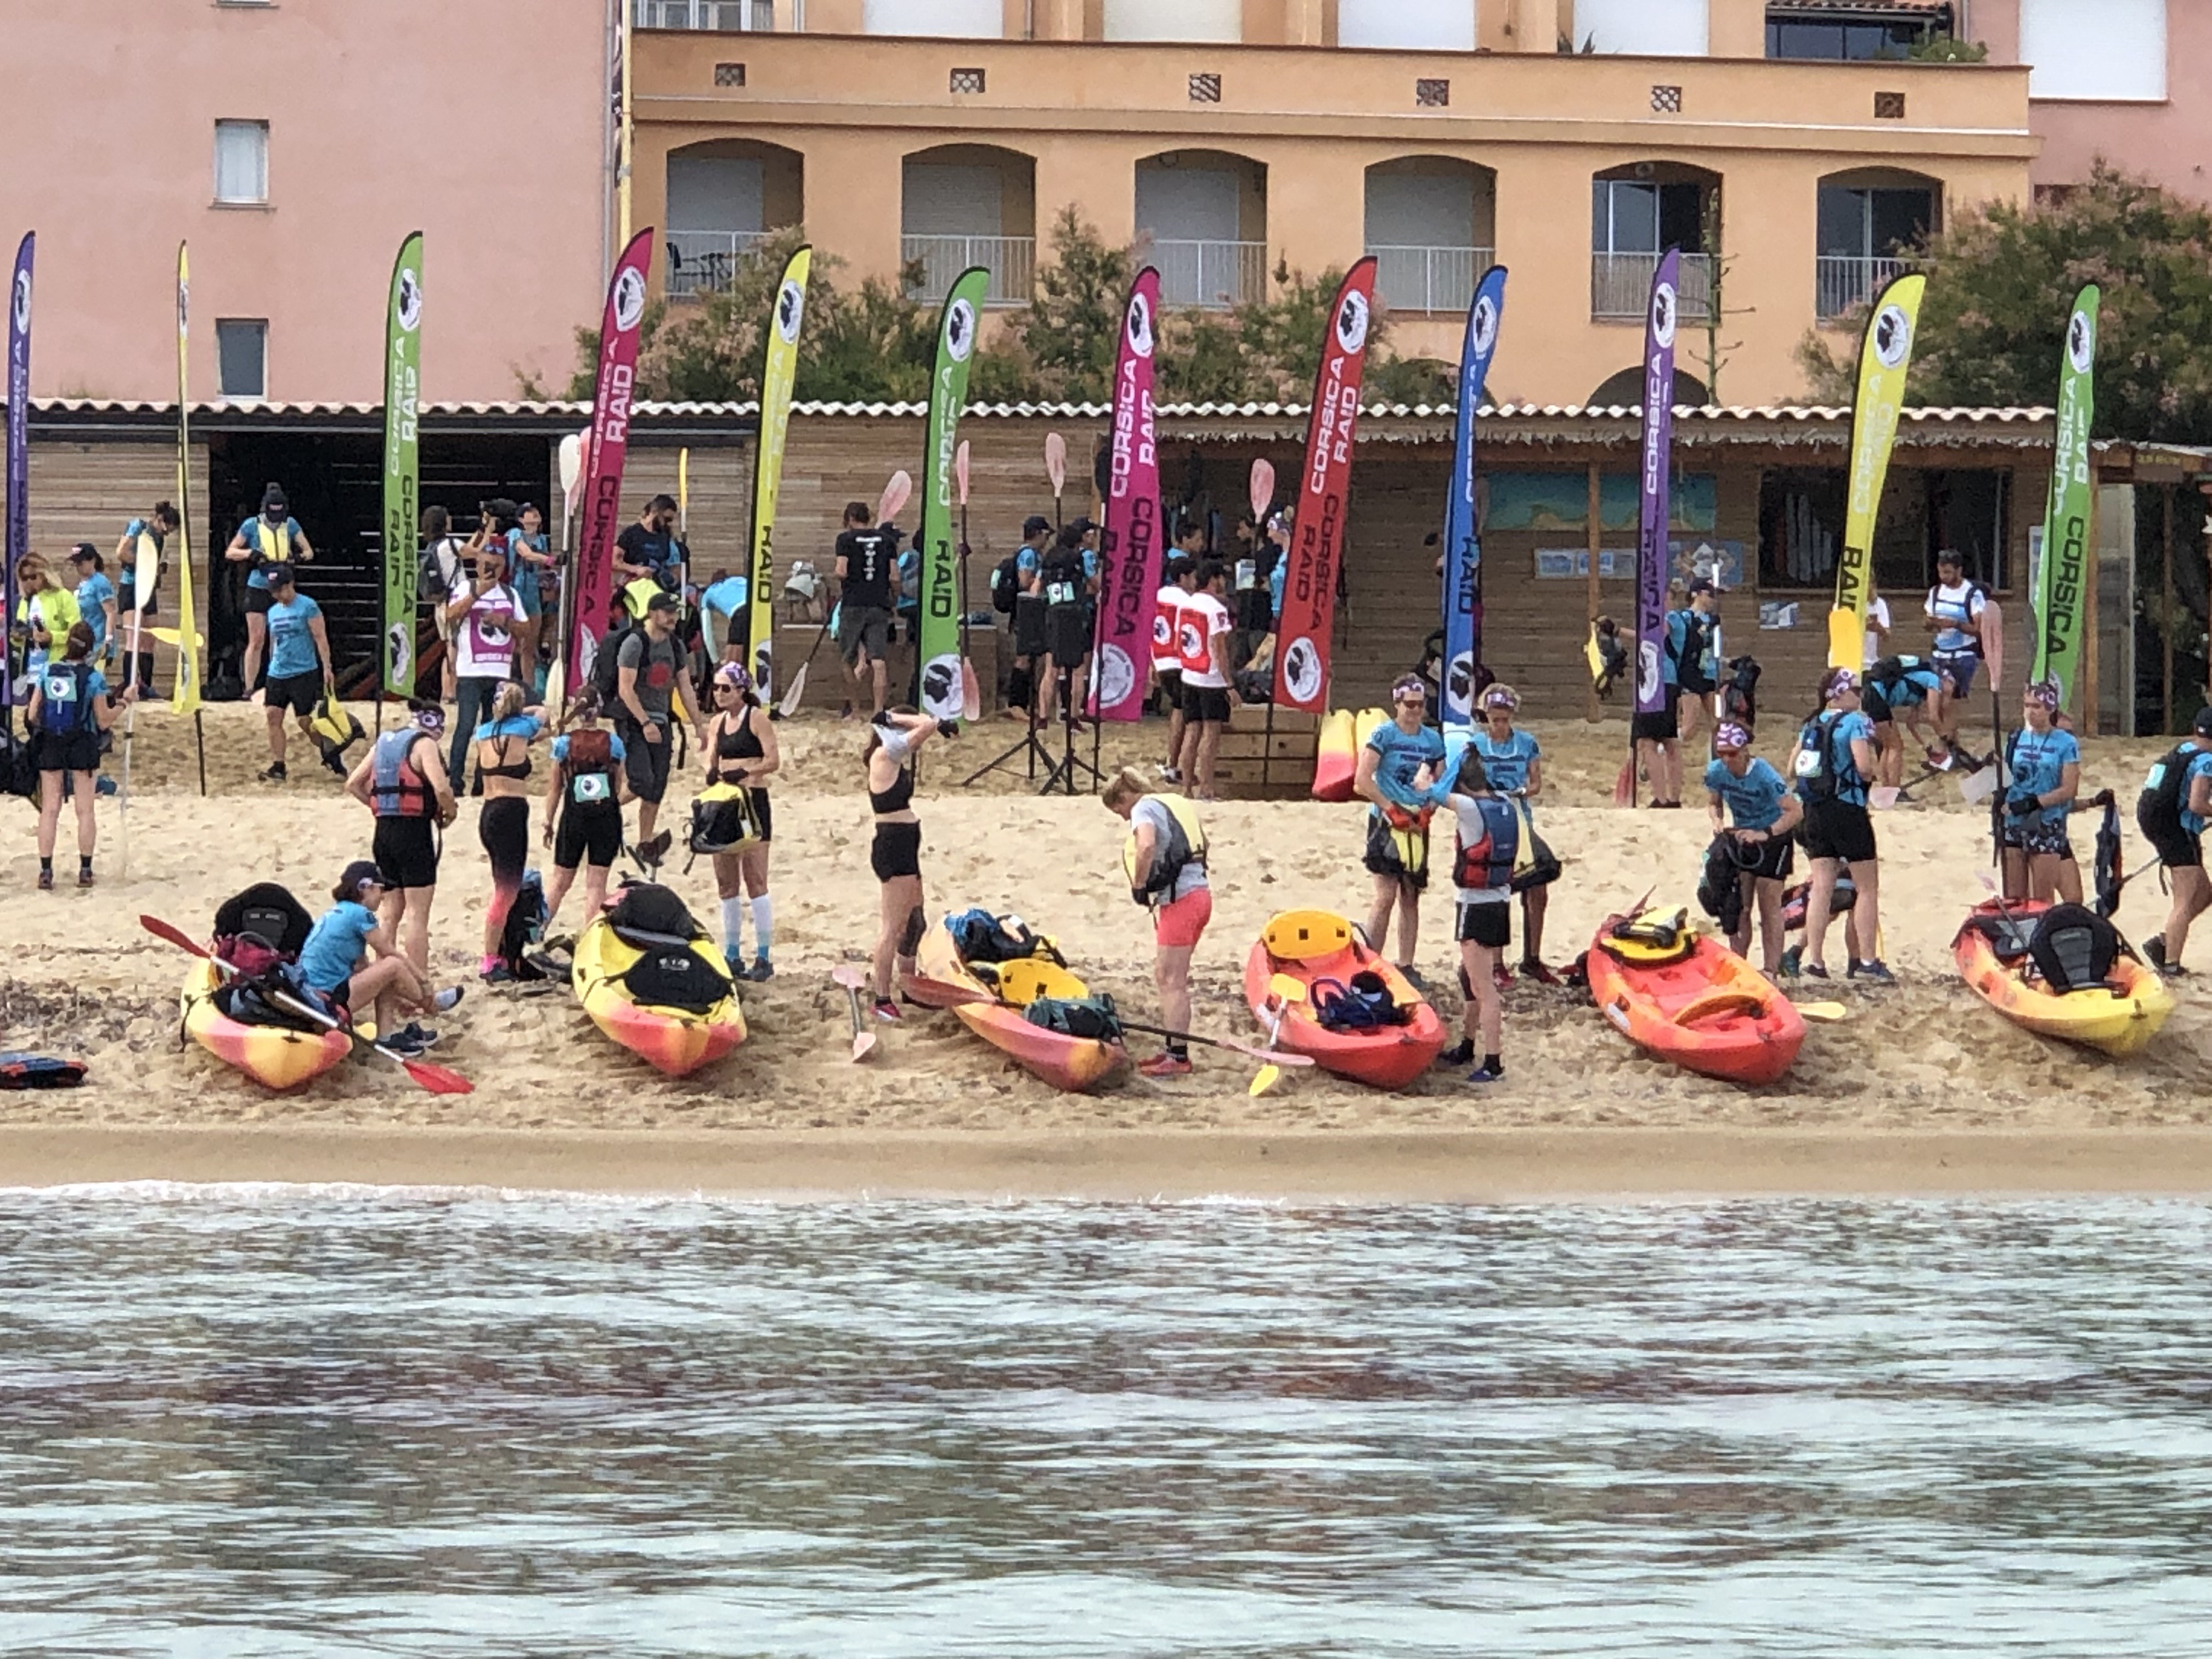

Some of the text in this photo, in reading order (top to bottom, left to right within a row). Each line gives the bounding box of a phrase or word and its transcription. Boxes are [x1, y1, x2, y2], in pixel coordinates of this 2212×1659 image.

[606, 364, 633, 442] RAID
[1111, 359, 1137, 498] CORSICA
[1311, 356, 1344, 494] CORSICA
[1333, 386, 1356, 464] RAID
[1647, 353, 1661, 494] CORSICA
[2074, 407, 2089, 484] RA
[402, 475, 415, 614] CORSICA
[931, 540, 952, 617] RAID
[1114, 497, 1153, 636] CORSICA
[1296, 524, 1317, 602] RAID
[1310, 493, 1339, 630] CORSICA
[1839, 546, 1863, 611] RAI
[2046, 516, 2084, 654] CORSICA
